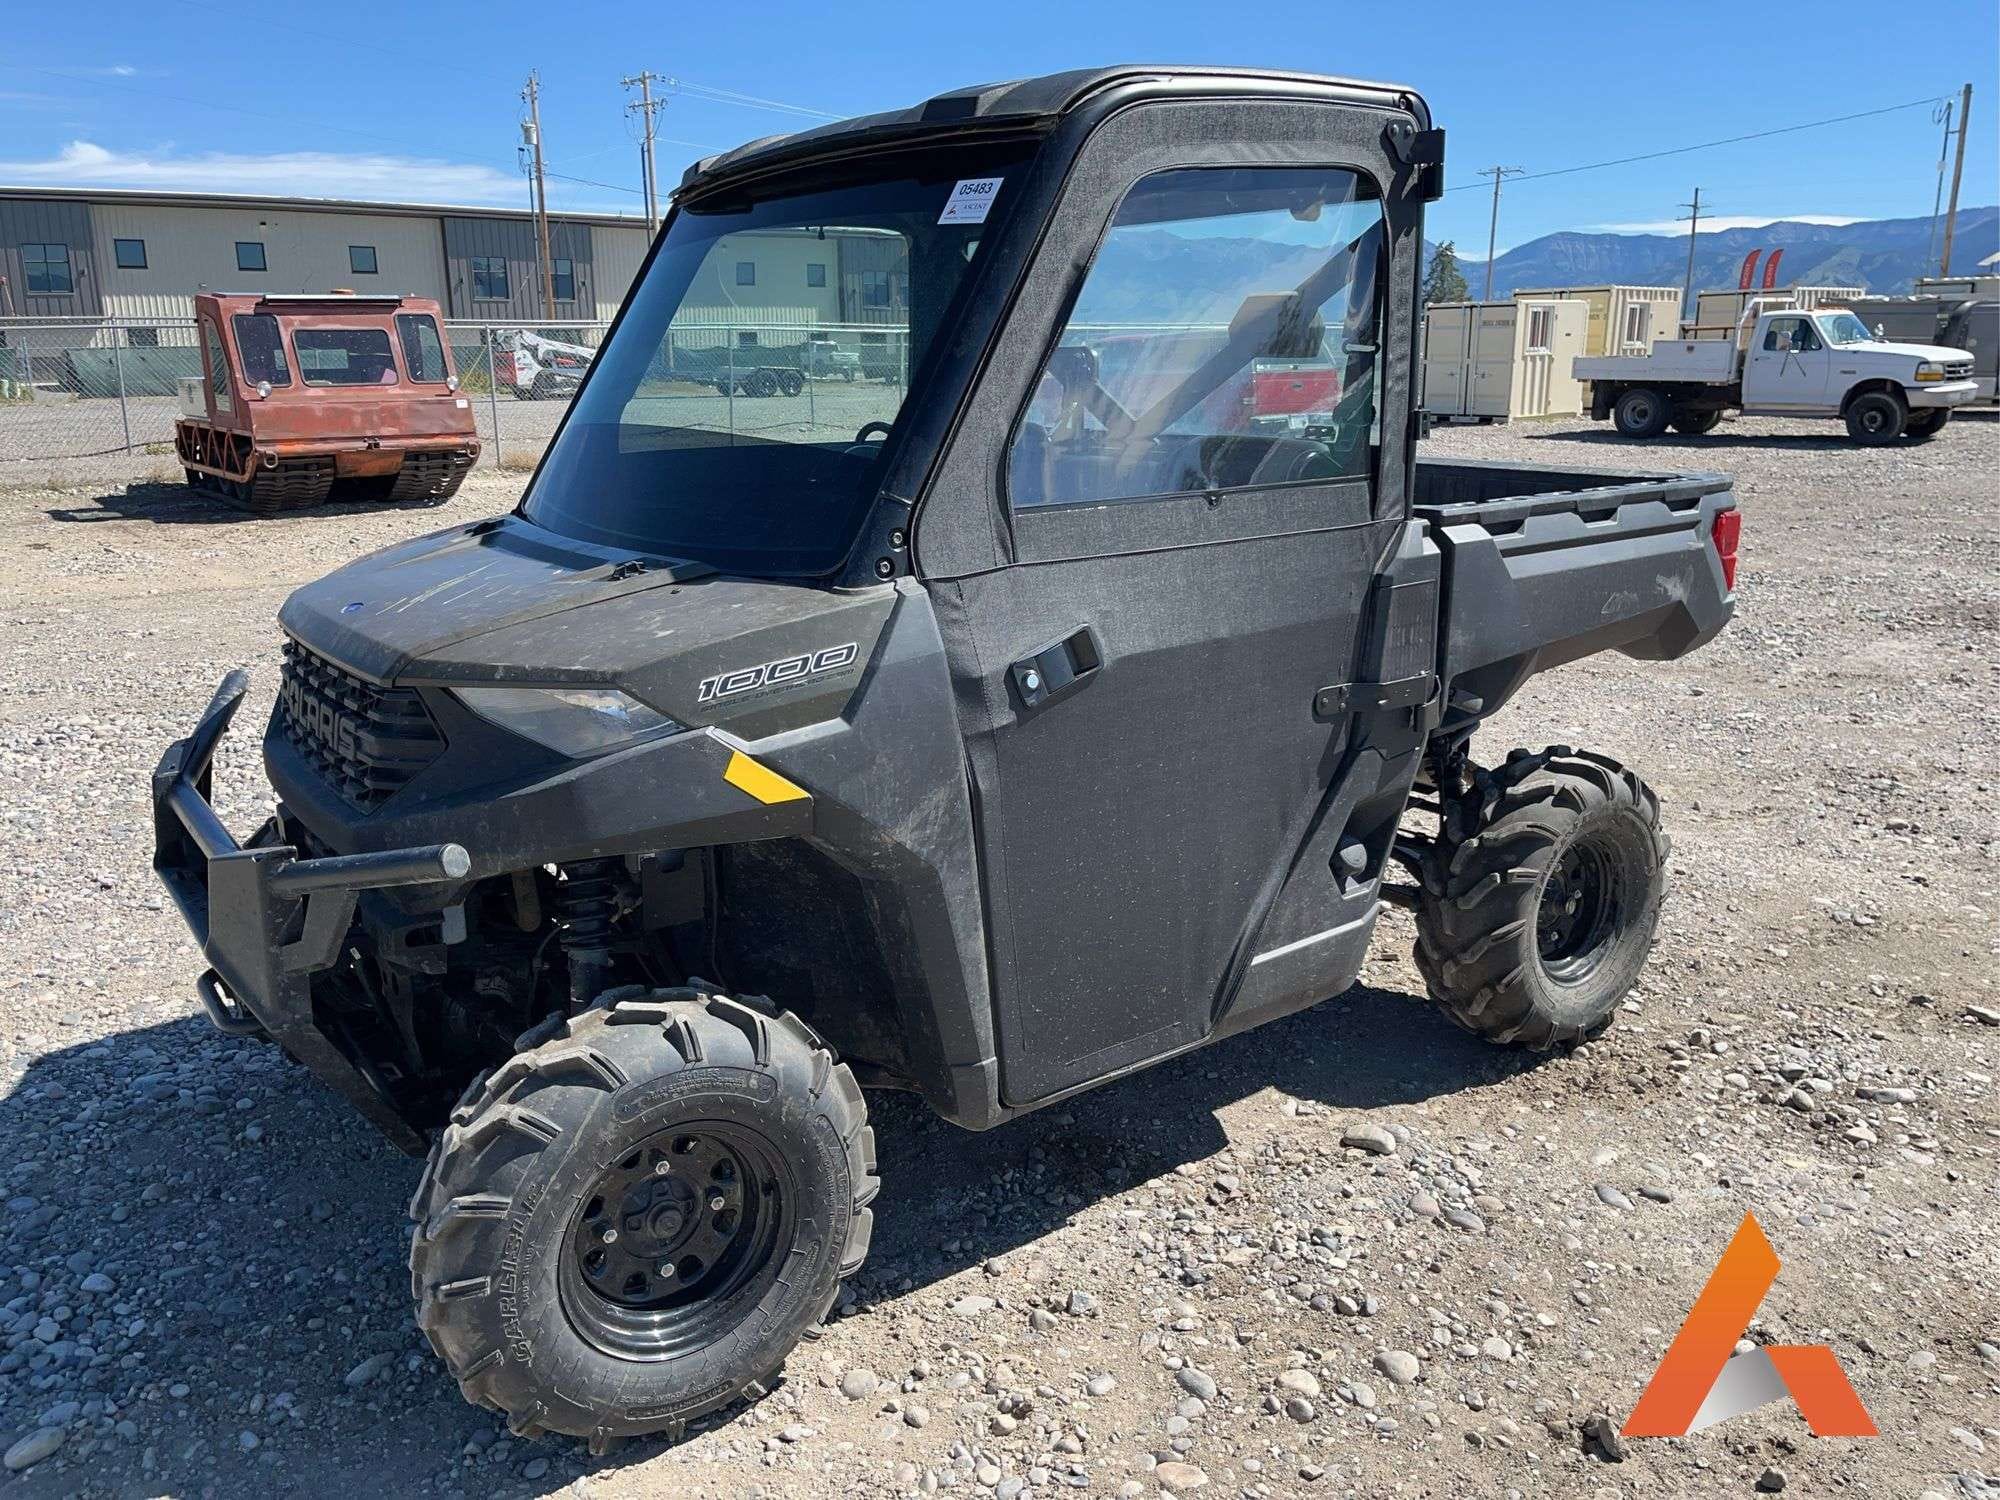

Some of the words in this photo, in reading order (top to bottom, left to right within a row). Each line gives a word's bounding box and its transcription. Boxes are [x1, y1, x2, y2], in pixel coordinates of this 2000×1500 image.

[960, 182, 993, 196] 05483
[697, 642, 860, 702] 1000
[281, 672, 356, 761] POLARIS
